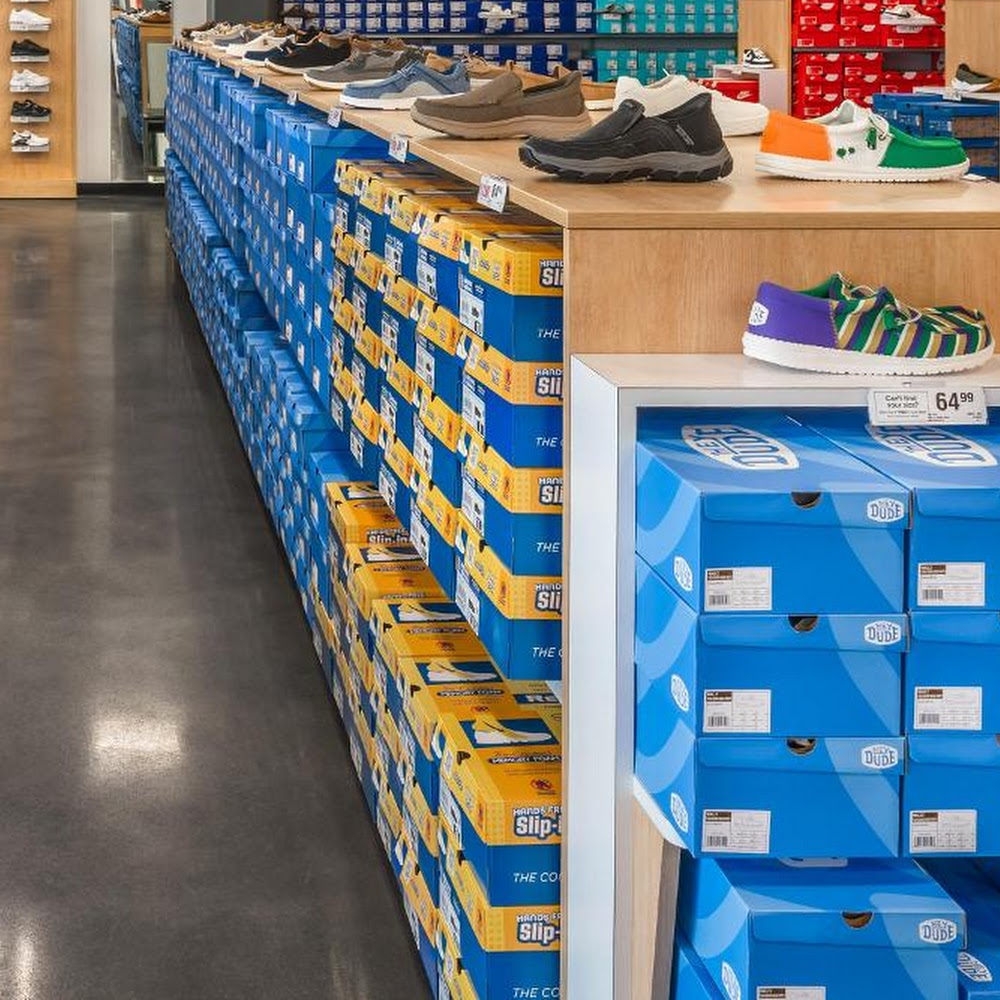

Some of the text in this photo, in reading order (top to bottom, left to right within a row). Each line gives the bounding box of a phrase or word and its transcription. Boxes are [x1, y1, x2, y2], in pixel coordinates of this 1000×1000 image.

[538, 329, 561, 339] THE
[536, 369, 563, 377] HAND
[537, 376, 562, 395] Sli
[536, 436, 558, 447] THE
[694, 427, 787, 466] DUDE
[871, 503, 902, 520] DUDE
[536, 542, 561, 553] THE
[535, 583, 563, 591] HAND
[537, 591, 562, 609] Sli
[868, 626, 899, 642] DUDE
[532, 647, 557, 658] THE
[864, 750, 896, 766] DUDE
[516, 815, 562, 838] Slip-i
[513, 871, 561, 883] THE CO
[519, 922, 561, 944] Slip-
[923, 924, 955, 941] DUDE
[512, 987, 539, 998] THE
